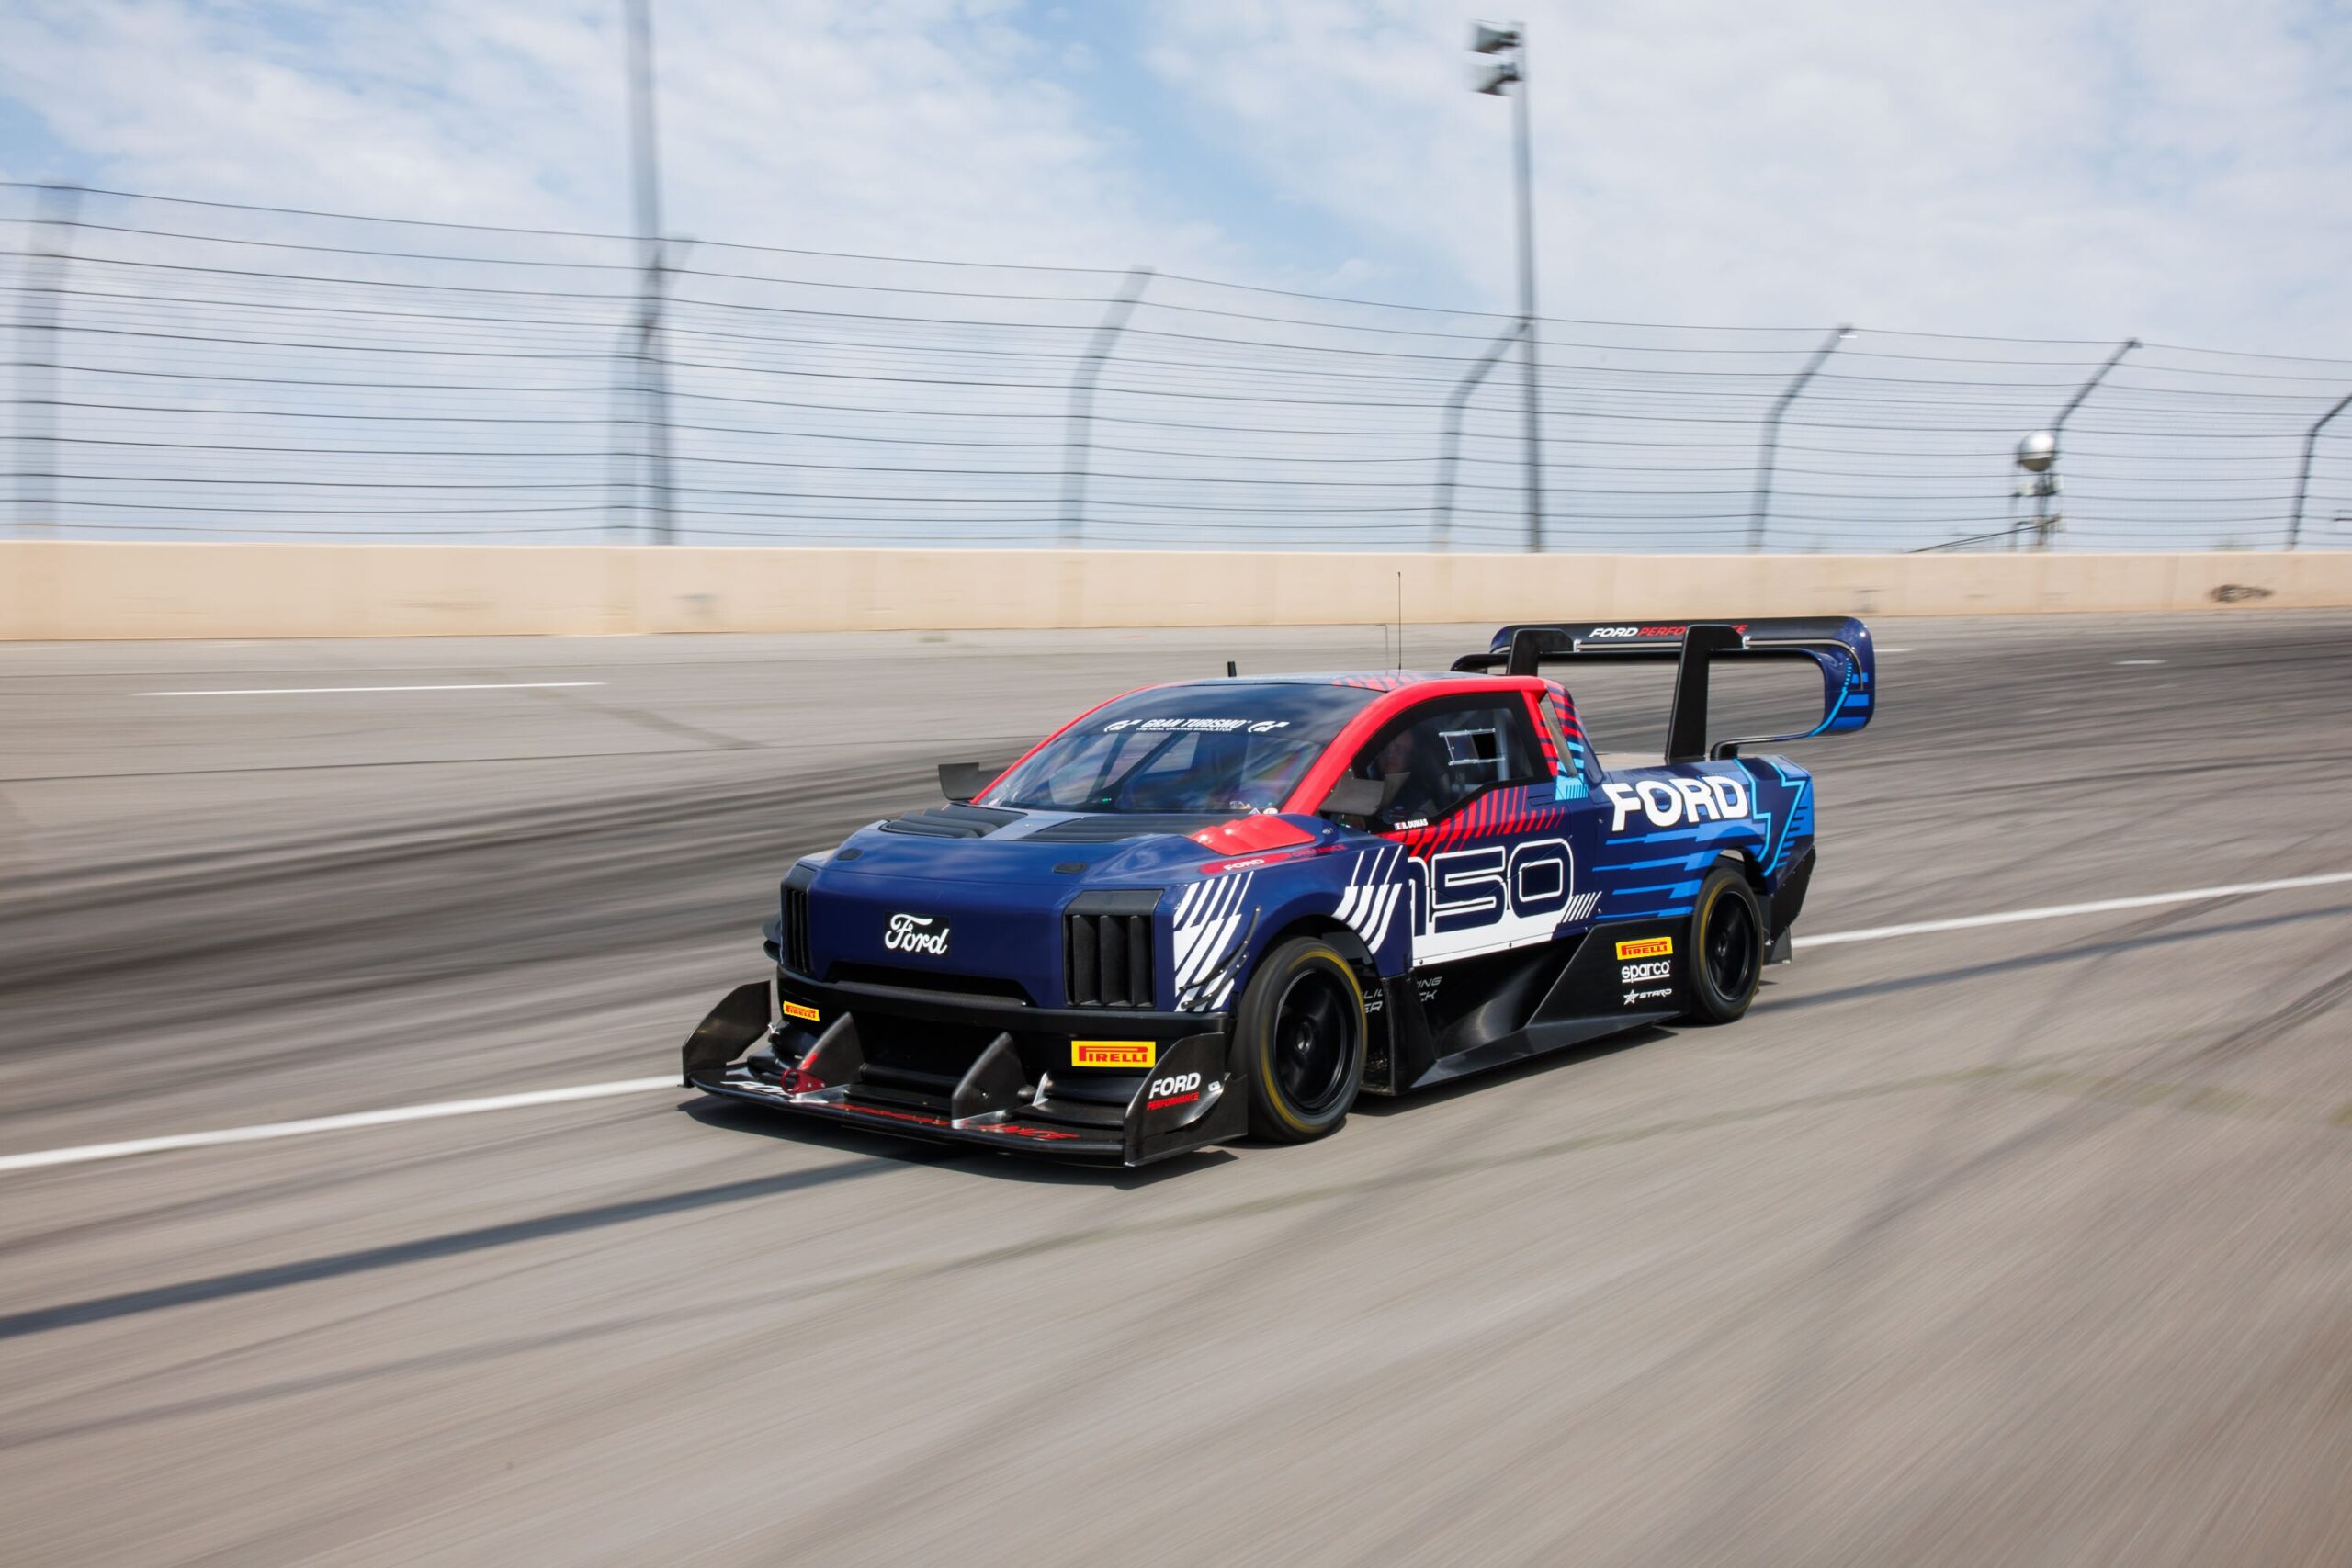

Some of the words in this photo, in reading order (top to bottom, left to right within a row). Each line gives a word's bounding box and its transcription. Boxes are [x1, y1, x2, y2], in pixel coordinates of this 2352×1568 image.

[1589, 627, 1639, 637] FORD
[1140, 718, 1186, 728] GRAN
[1181, 718, 1248, 729] TURISMO
[1601, 775, 1749, 832] FORD
[1223, 858, 1265, 872] FORD
[885, 913, 950, 955] Ford
[1621, 941, 1668, 956] PIRELLI
[1621, 961, 1670, 983] sparco
[786, 1004, 816, 1019] PIRELLI
[1079, 1045, 1148, 1063] PIRELLI
[1148, 1072, 1202, 1100] FORD
[1147, 1091, 1200, 1111] PERFORMANCE
